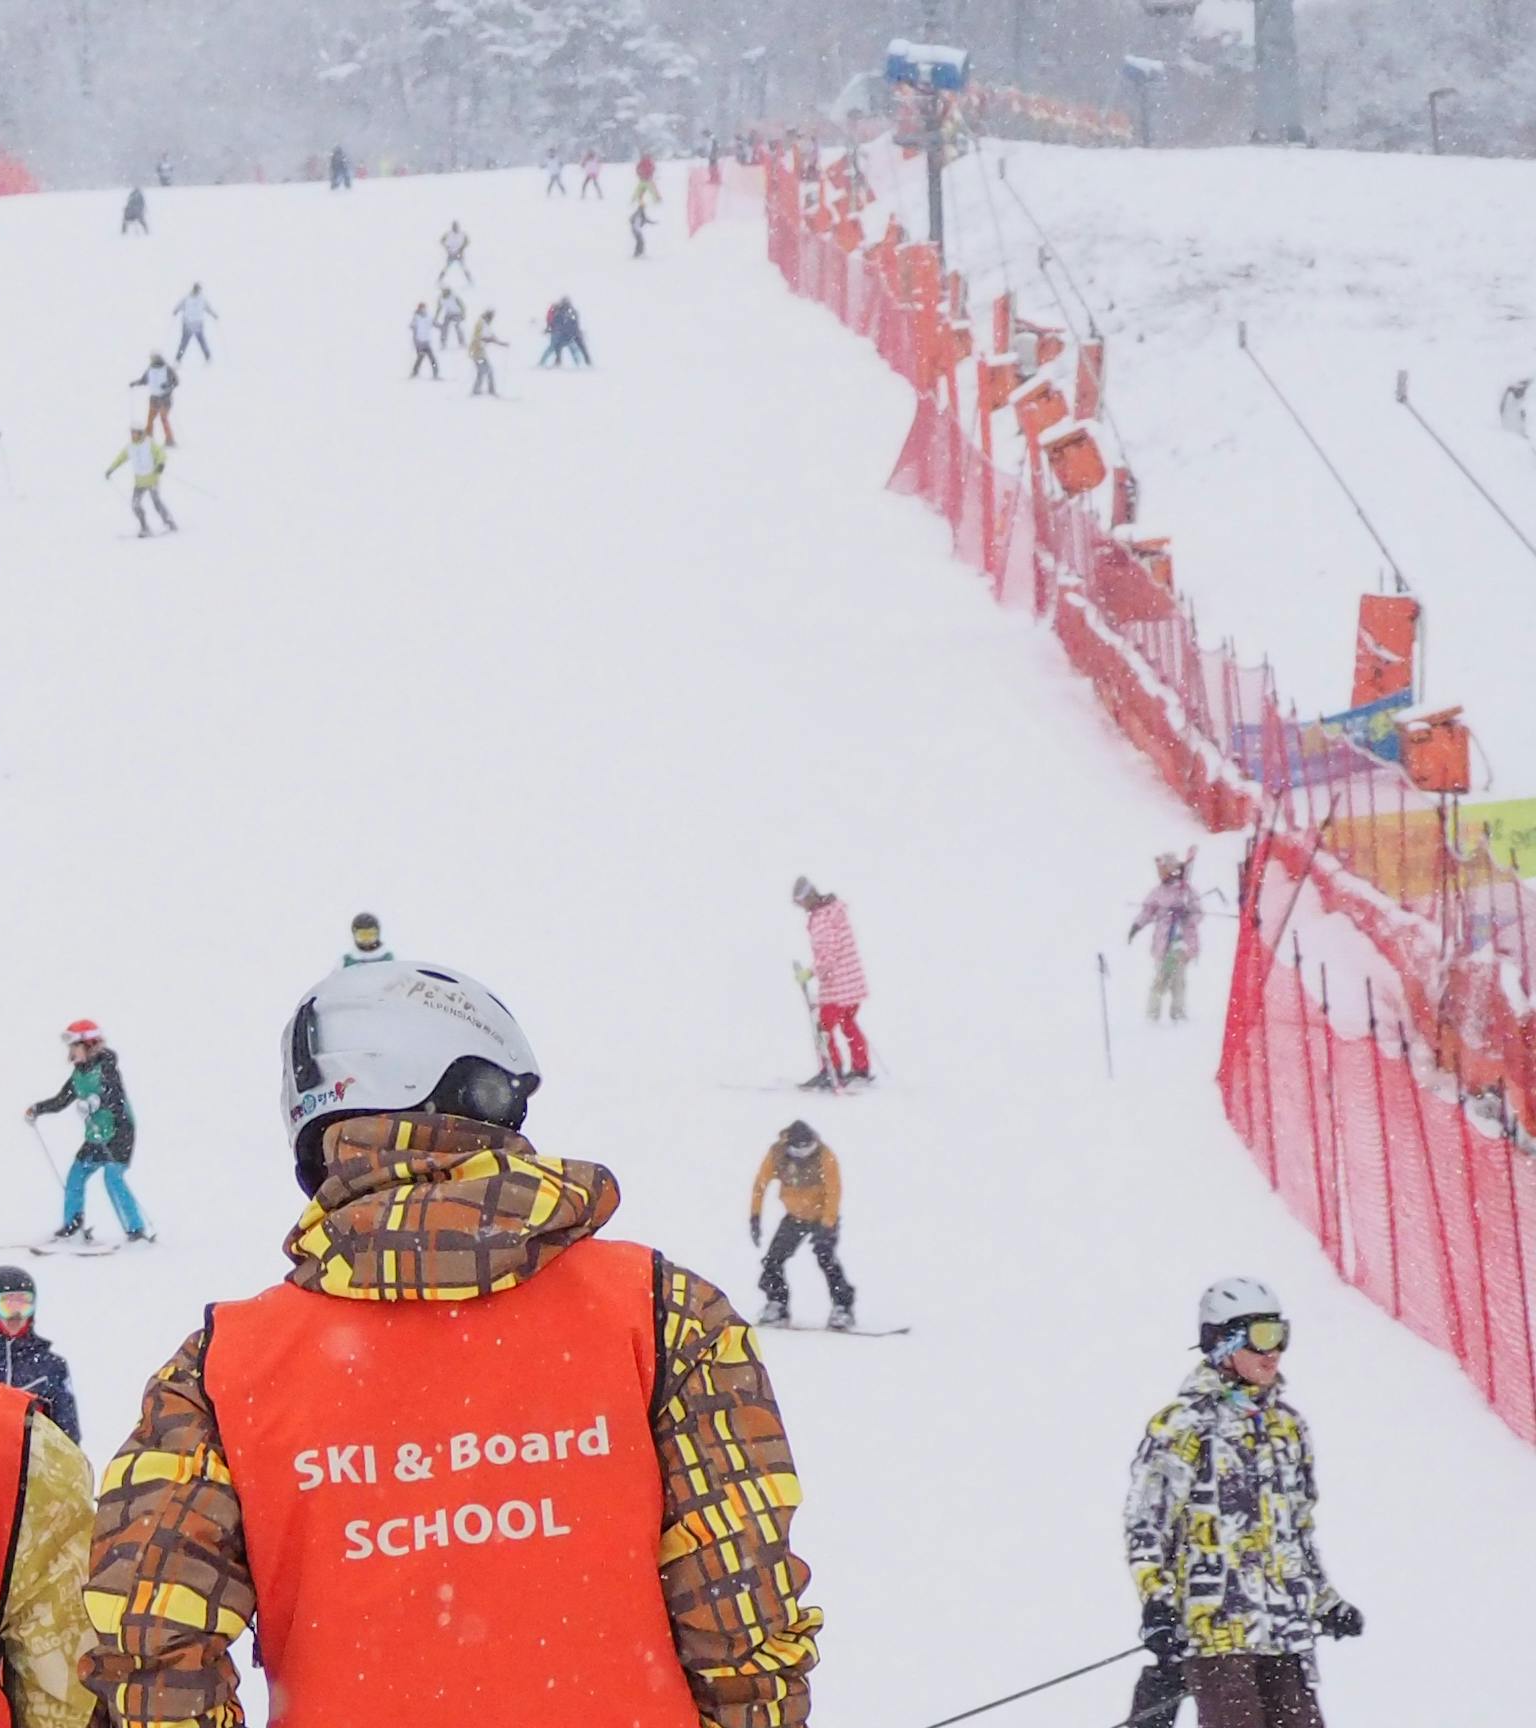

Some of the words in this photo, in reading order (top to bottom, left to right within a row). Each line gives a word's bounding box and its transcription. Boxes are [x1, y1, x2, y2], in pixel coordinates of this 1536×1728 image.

[294, 1445, 377, 1491] SKI
[394, 1442, 435, 1482] &
[449, 1415, 611, 1472] Board
[344, 1498, 571, 1560] SCHOOL
